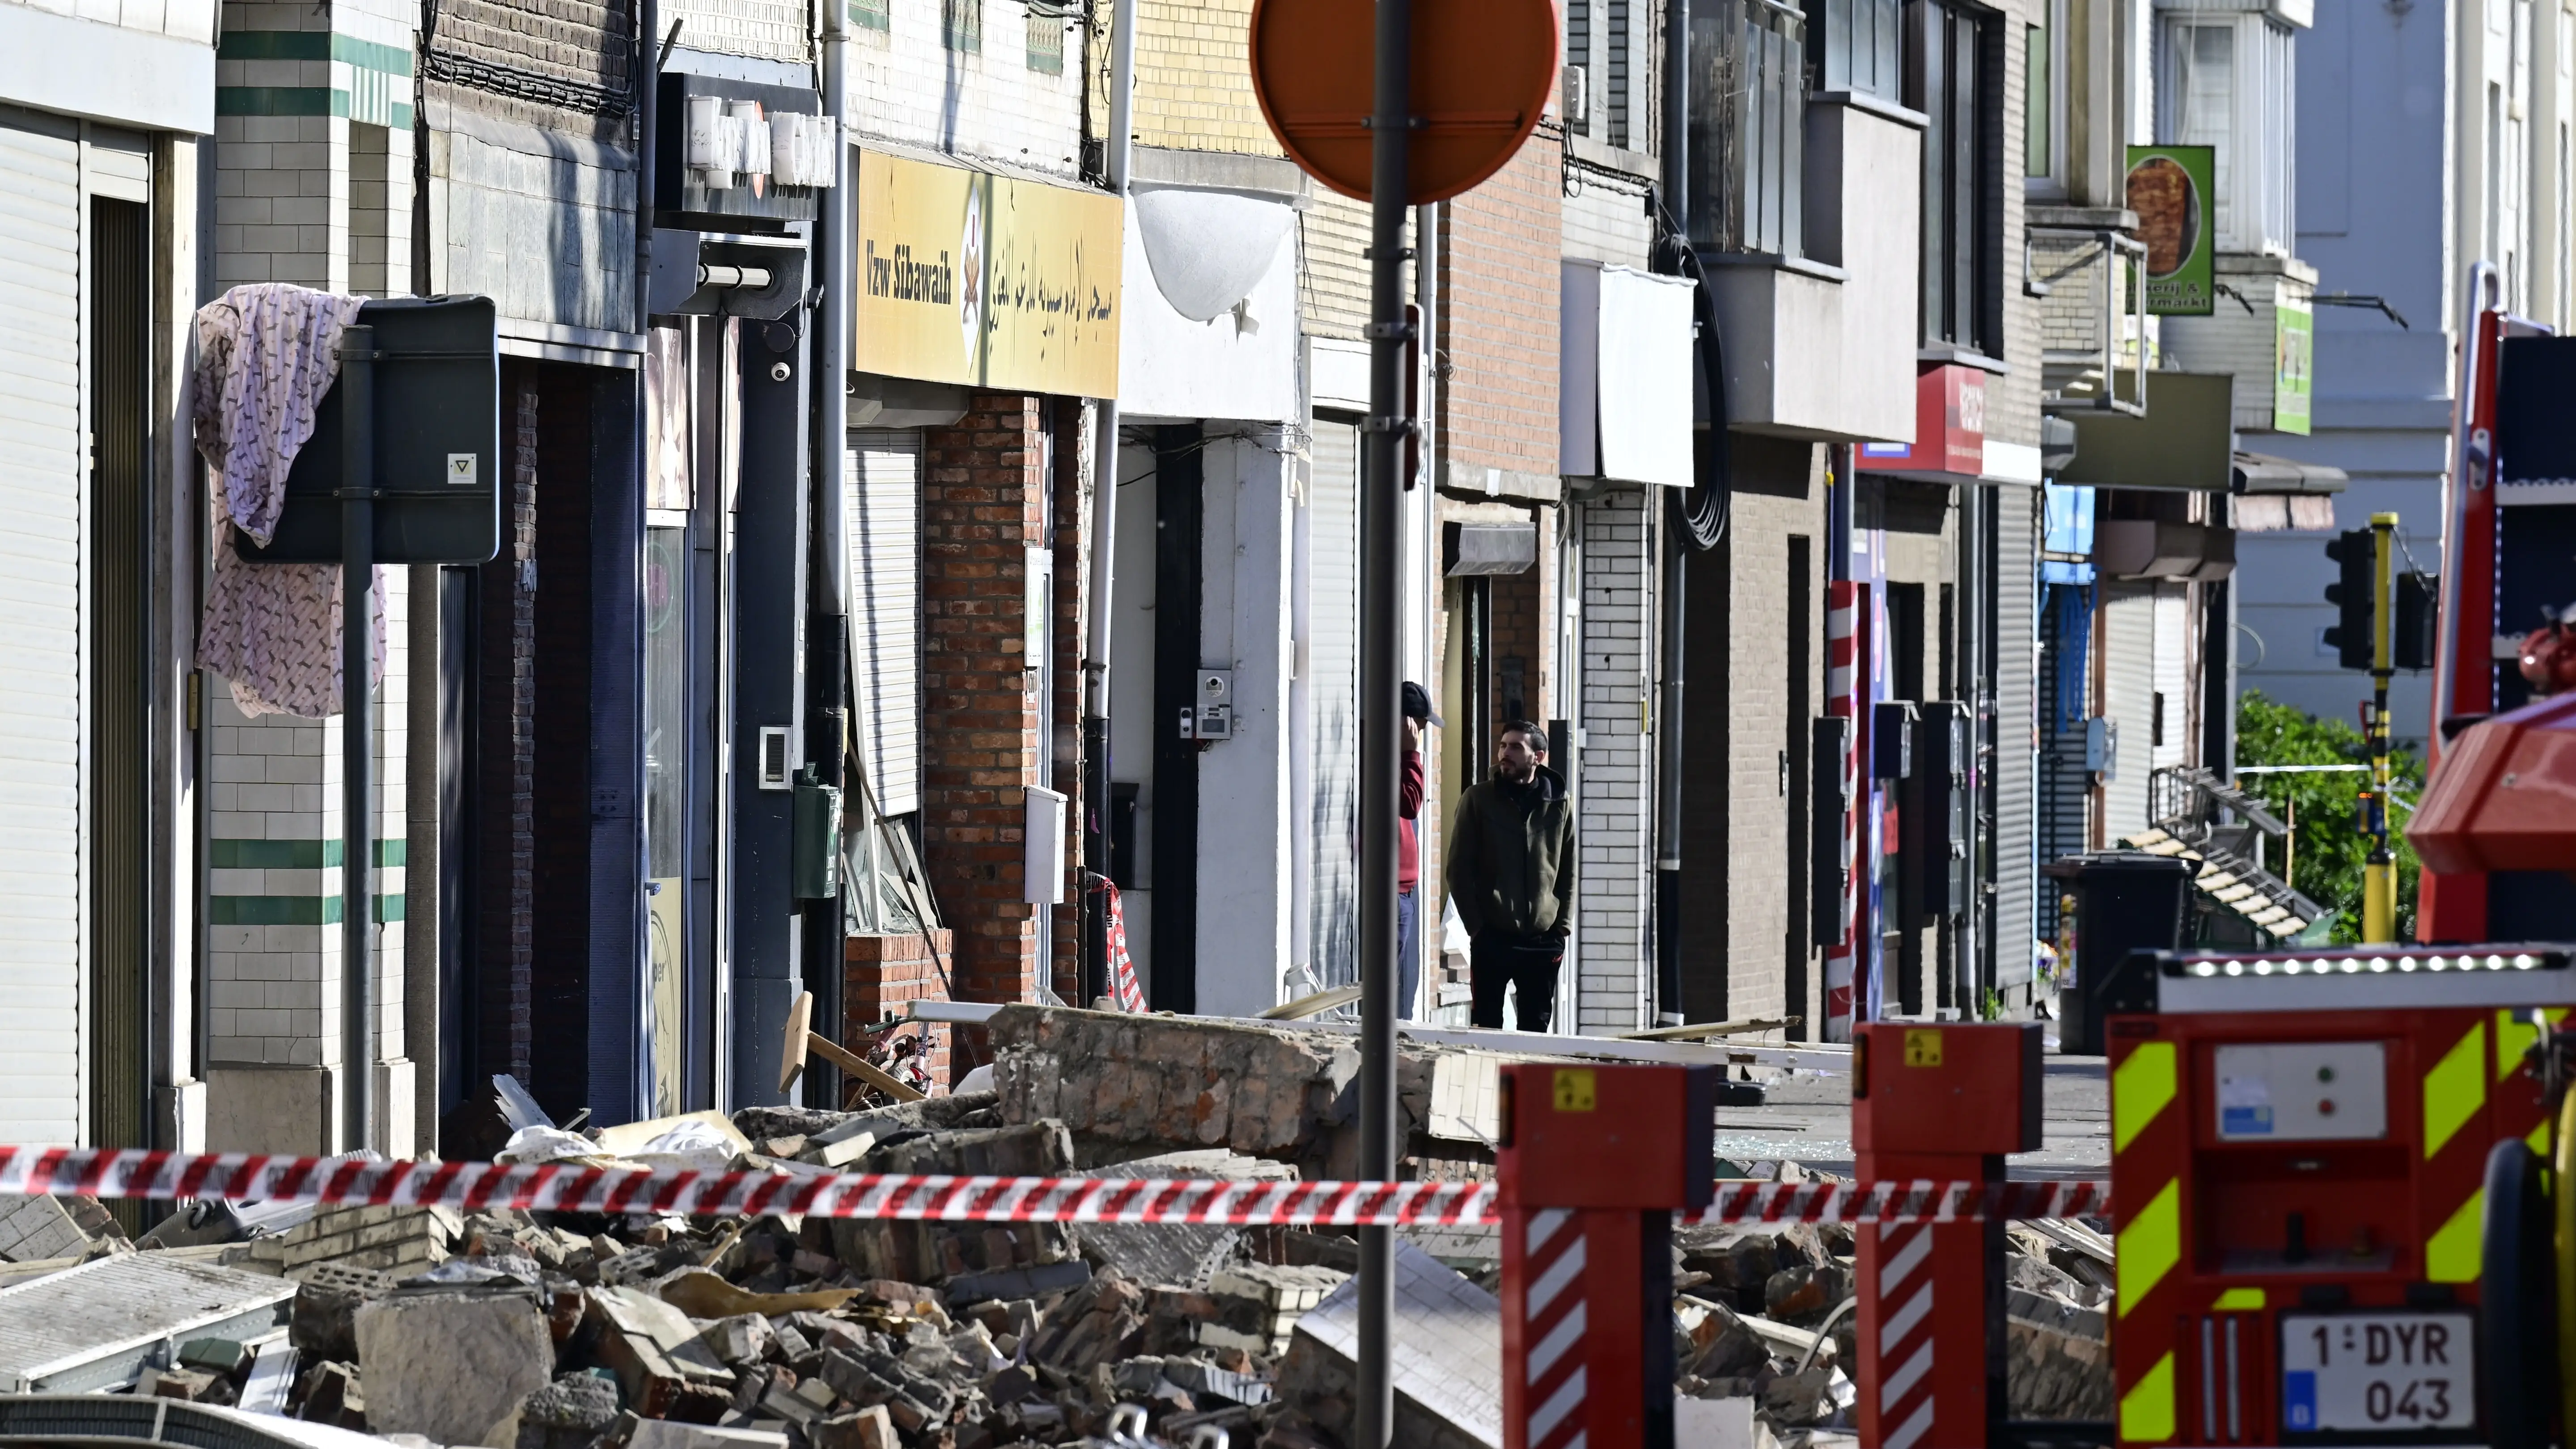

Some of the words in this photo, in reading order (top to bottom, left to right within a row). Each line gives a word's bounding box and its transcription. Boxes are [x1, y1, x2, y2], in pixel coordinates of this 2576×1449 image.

[867, 239, 891, 298] Vzw
[894, 244, 951, 305] Sibawaih
[1087, 275, 1112, 342] مسجد
[2365, 1378, 2451, 1424] 043
